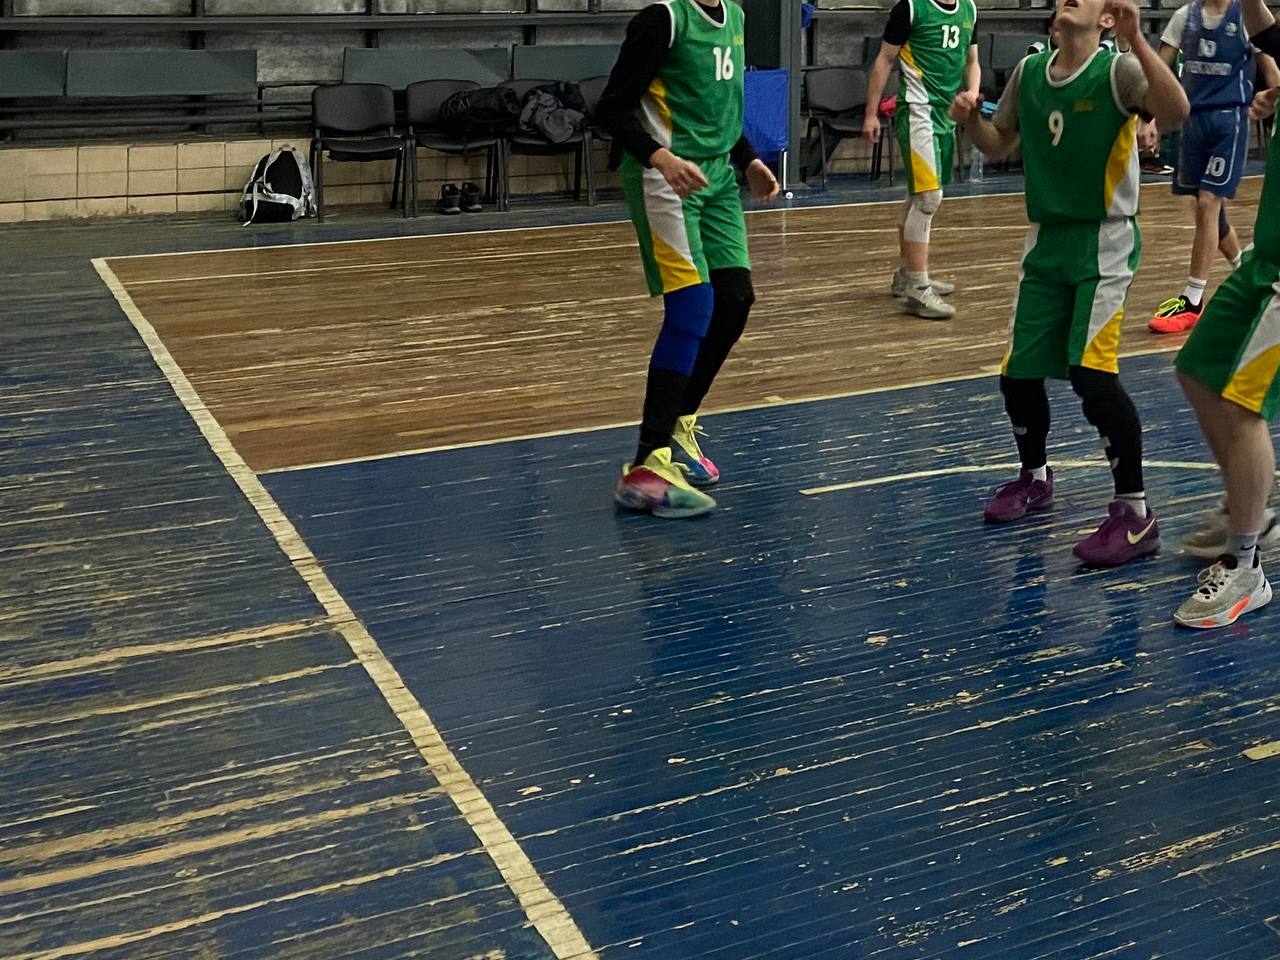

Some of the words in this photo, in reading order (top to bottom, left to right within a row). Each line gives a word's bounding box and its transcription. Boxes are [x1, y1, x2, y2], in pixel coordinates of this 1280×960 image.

[941, 25, 960, 48] 13
[713, 46, 734, 80] 16
[1048, 110, 1064, 146] 9
